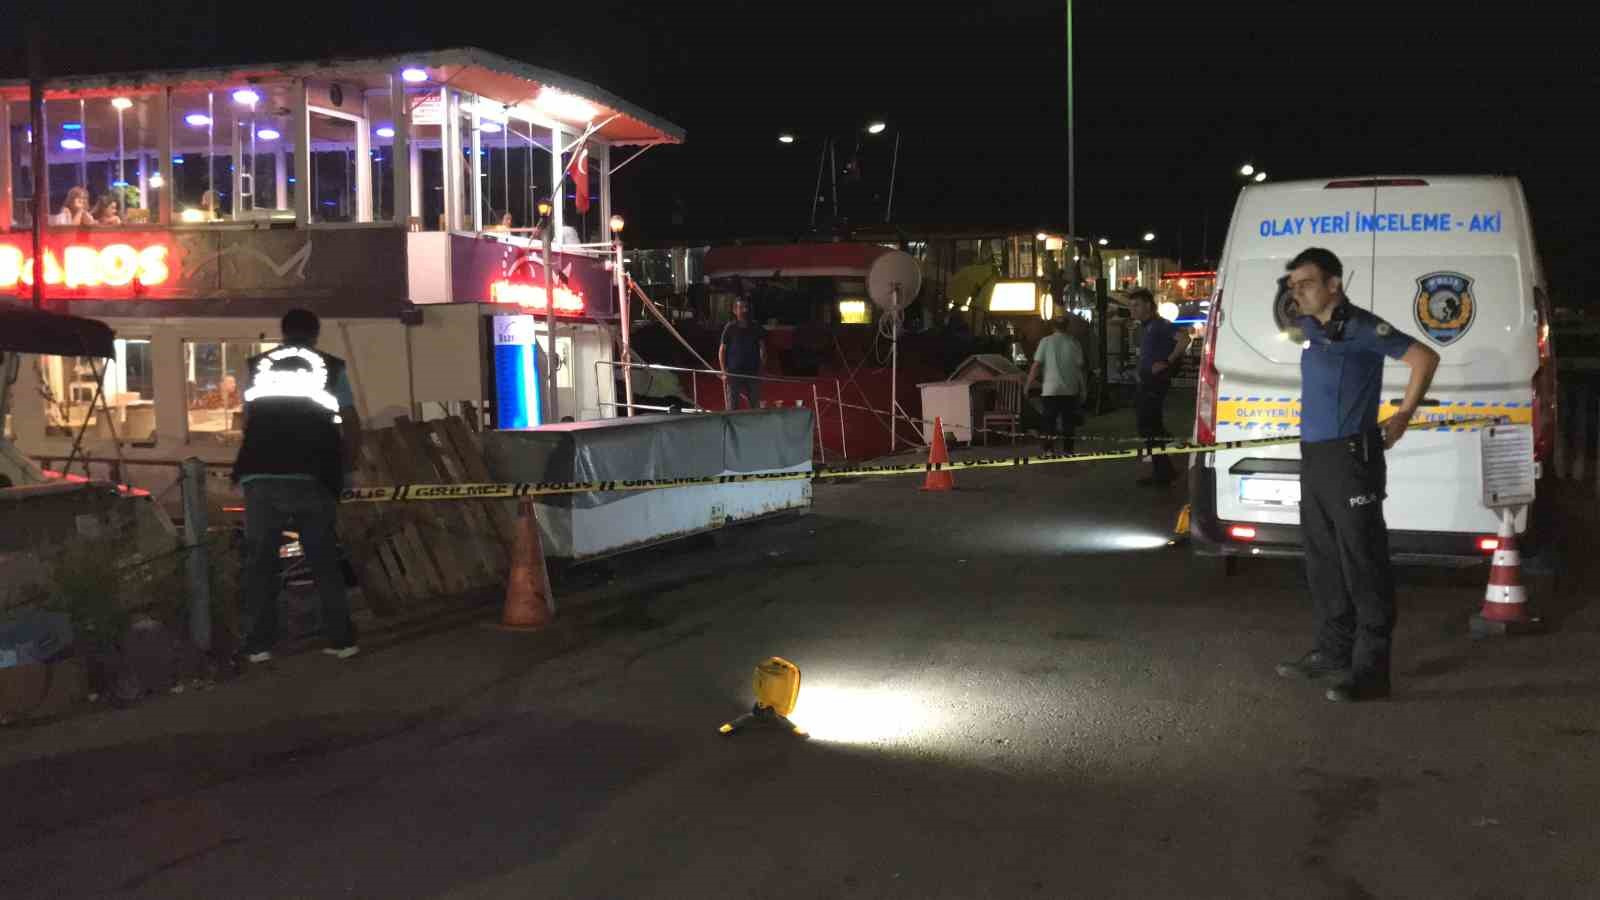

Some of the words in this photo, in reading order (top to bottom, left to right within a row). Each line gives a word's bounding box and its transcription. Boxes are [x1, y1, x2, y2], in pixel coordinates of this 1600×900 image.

[1259, 217, 1304, 237] OLAY
[1310, 211, 1349, 234] YERİ
[1355, 211, 1451, 233] İNCELEME
[1469, 210, 1501, 233] AKİ
